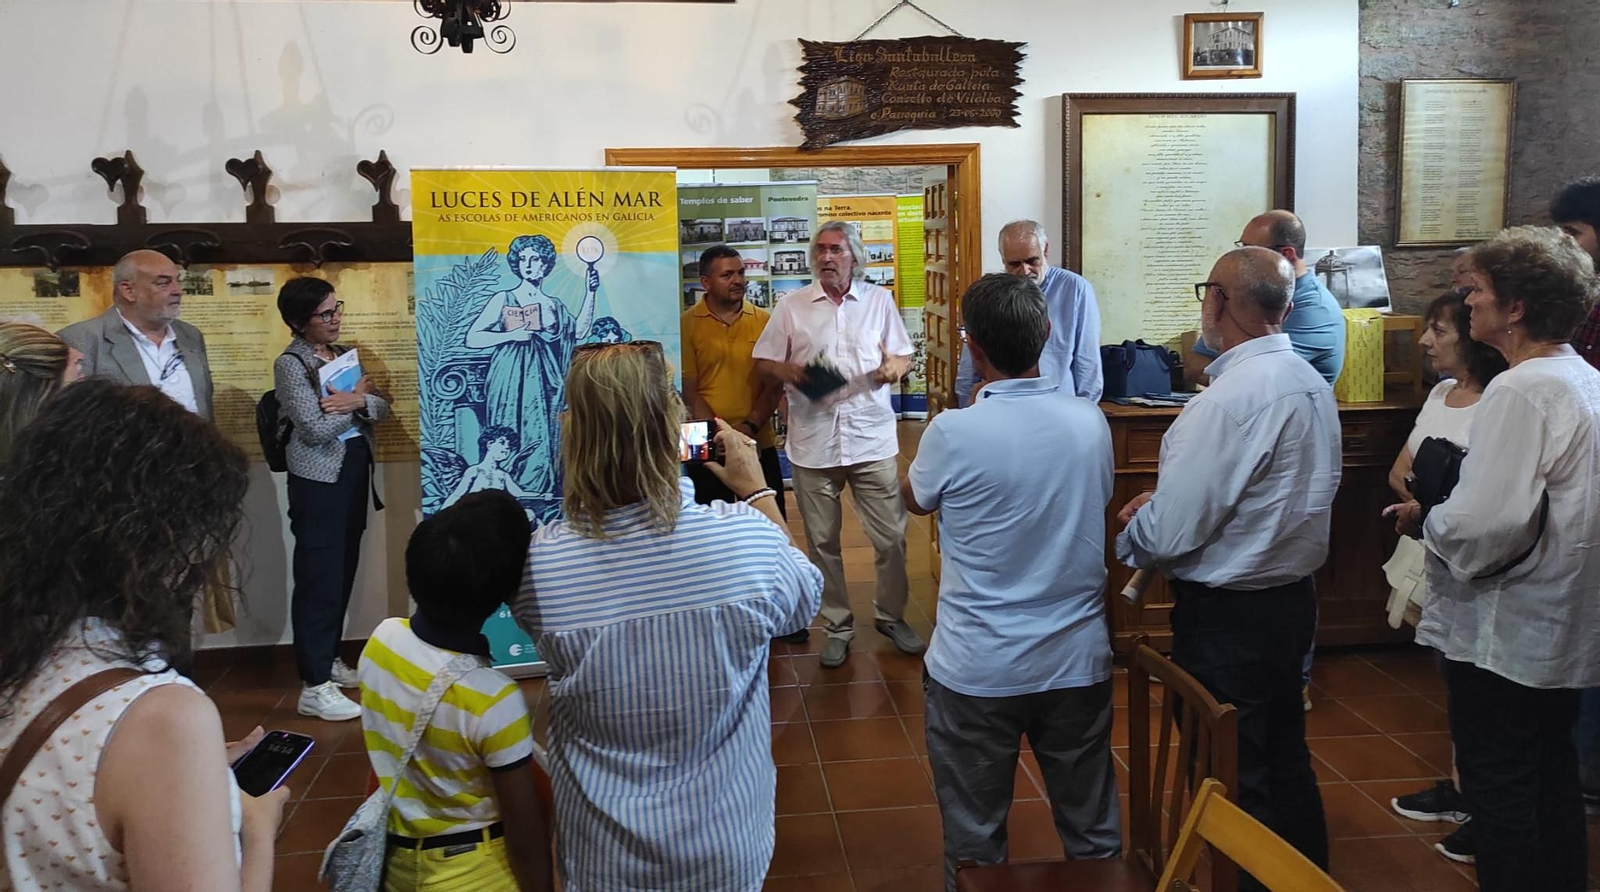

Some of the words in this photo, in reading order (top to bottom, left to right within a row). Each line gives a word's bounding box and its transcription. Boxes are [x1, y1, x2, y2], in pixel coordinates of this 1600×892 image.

[833, 46, 873, 67] Liga
[890, 66, 967, 79] Restaurada
[970, 66, 1000, 79] pola
[936, 92, 954, 103] de
[881, 107, 936, 122] Parroquia
[431, 191, 502, 208] LUCES
[511, 191, 542, 208] DE
[547, 187, 604, 208] ALÉN
[613, 190, 662, 207] MAR
[679, 197, 715, 206] Templos
[730, 195, 754, 204] saber
[438, 213, 451, 222] AS
[454, 213, 501, 222] ESCOLAS
[504, 213, 519, 222] DE
[521, 212, 593, 222] AMERICANOS
[596, 212, 610, 221] EN
[612, 212, 655, 221] GALICIA
[507, 307, 538, 317] CIENCIA
